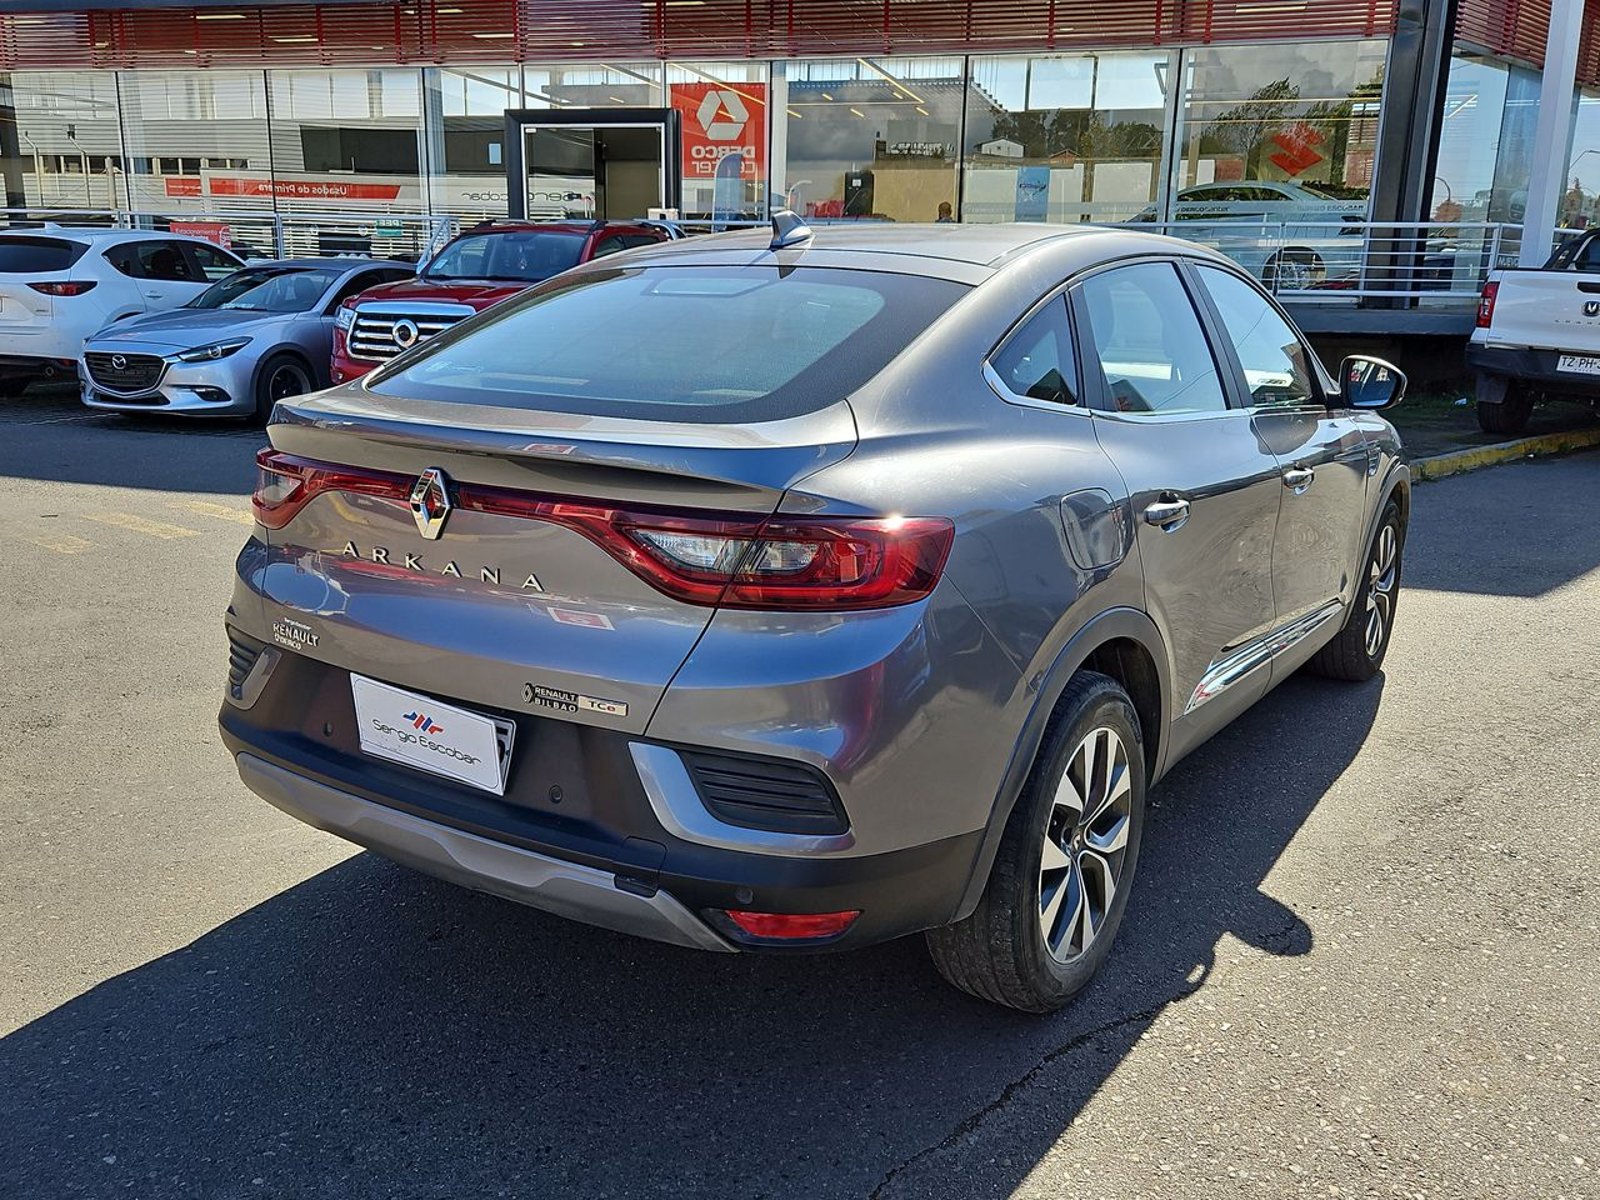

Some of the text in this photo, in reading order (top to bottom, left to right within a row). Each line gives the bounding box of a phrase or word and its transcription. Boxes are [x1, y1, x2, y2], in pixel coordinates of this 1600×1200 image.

[343, 541, 545, 592] ARKANA
[273, 623, 319, 647] RENAULT
[534, 687, 577, 702] RENAULT
[534, 697, 577, 712] BILBAO
[420, 735, 482, 766] Escobar
